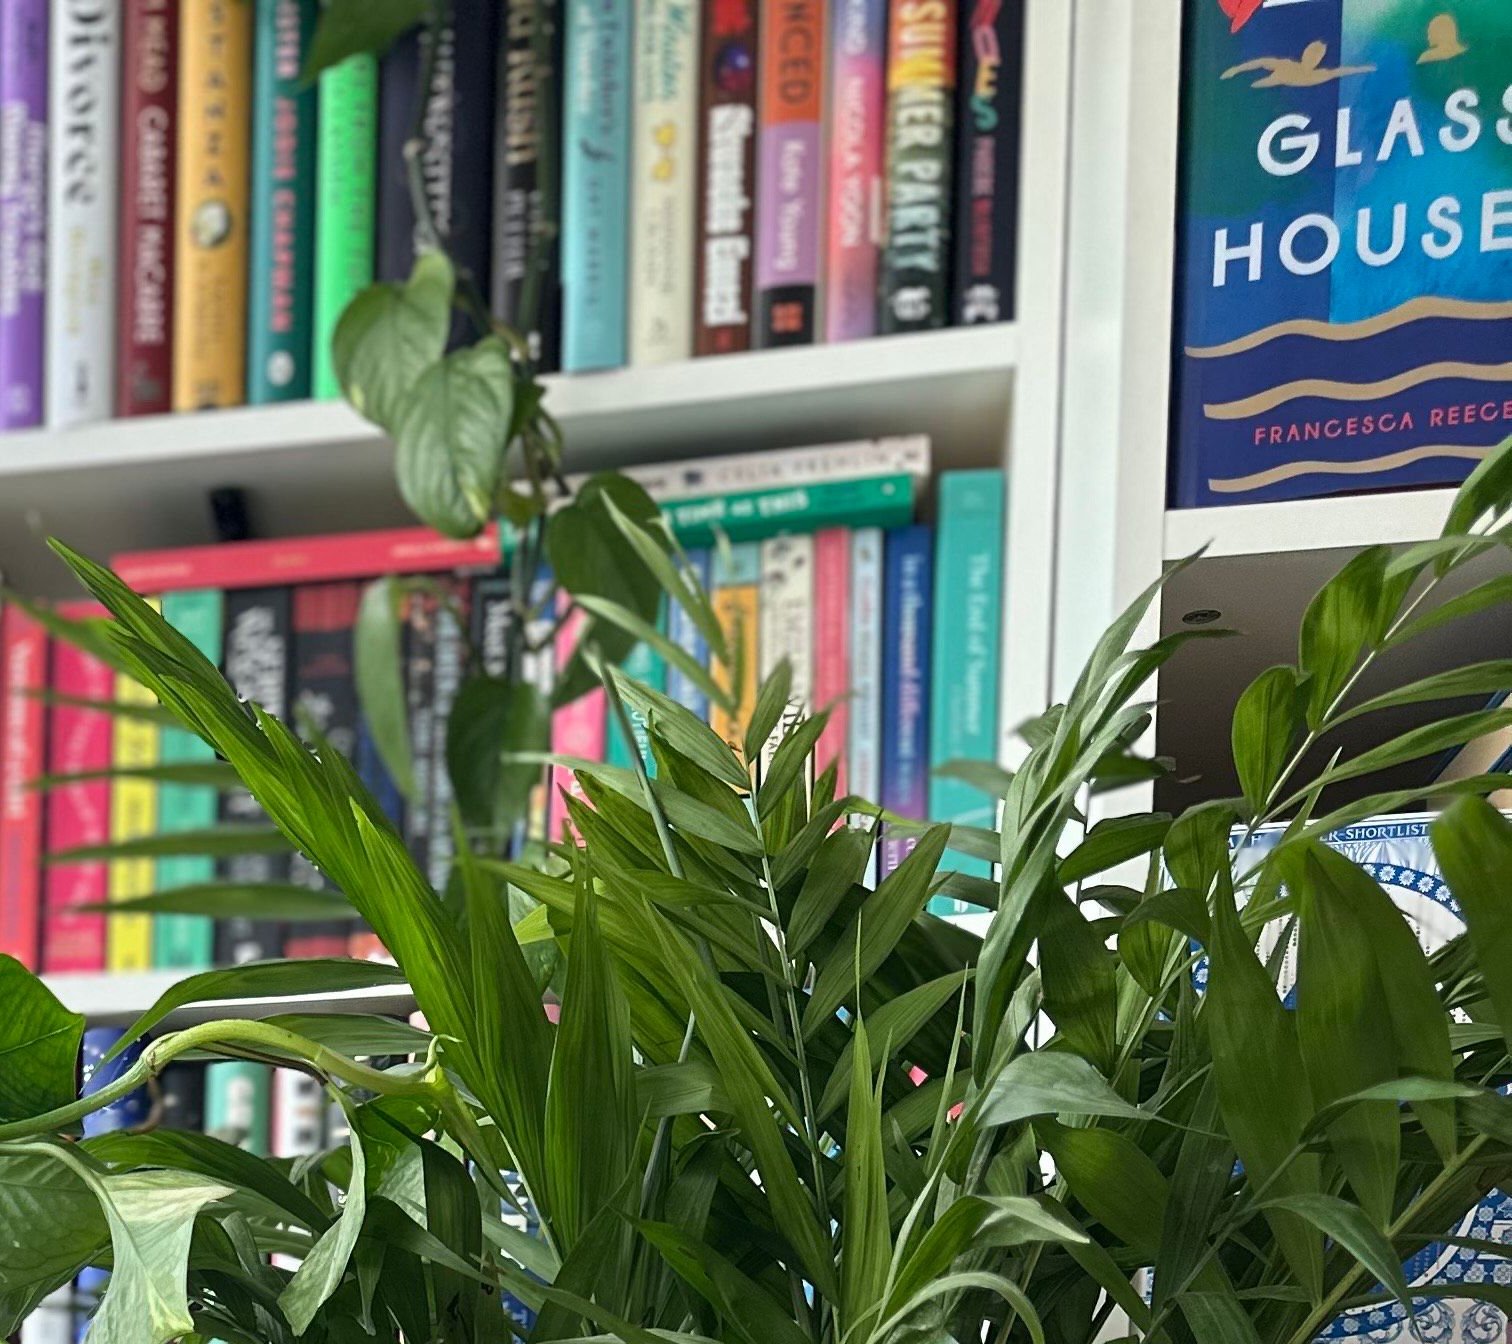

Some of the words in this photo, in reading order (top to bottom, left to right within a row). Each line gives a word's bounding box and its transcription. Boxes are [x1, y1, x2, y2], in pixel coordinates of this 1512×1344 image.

[772, 198, 805, 273] Young
[889, 157, 945, 274] PARTY
[1253, 412, 1414, 446] FRANCESCA
